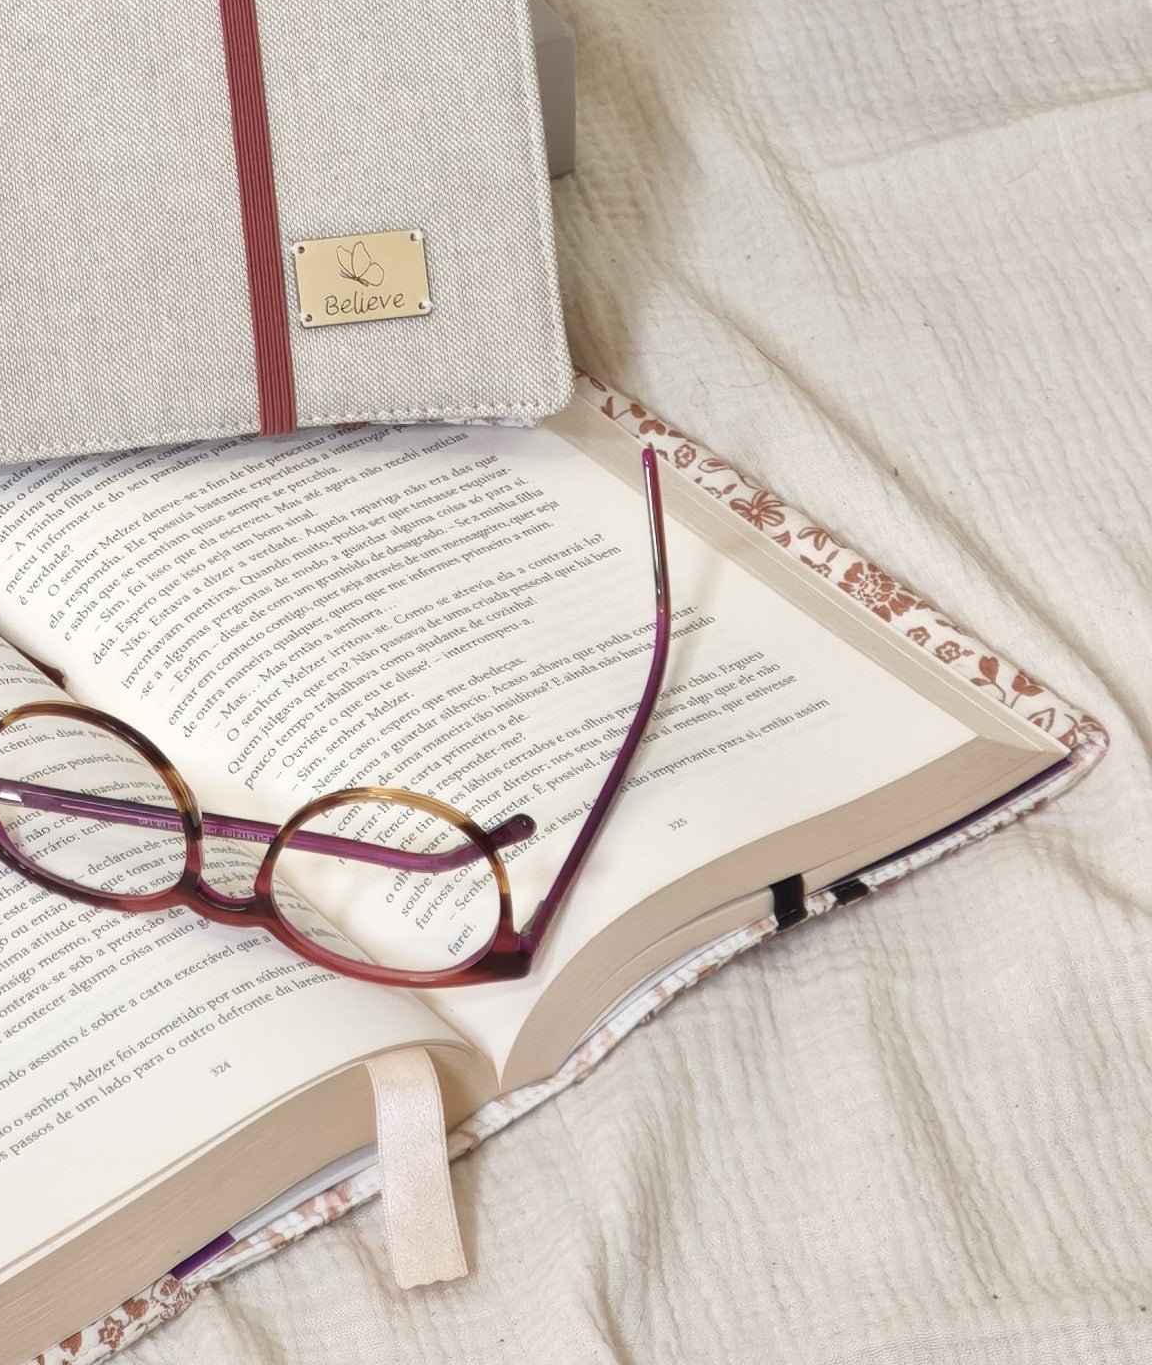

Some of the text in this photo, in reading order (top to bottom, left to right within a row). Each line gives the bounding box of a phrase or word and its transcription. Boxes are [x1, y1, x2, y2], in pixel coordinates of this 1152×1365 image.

[325, 290, 406, 316] Believe
[48, 456, 320, 630] ela respondia. Ele possuía bastante experiência
[91, 636, 119, 665] dela.
[113, 594, 158, 634] Espero
[156, 577, 182, 598] que
[178, 562, 207, 581] isso
[205, 548, 232, 566] seja
[250, 523, 285, 541] bom
[283, 507, 319, 528] sinal.
[667, 816, 688, 831] 325
[29, 918, 77, 950] atitude
[36, 934, 91, 969] mesmo,
[89, 916, 121, 940] pois
[7, 1121, 55, 1156] passos
[96, 1073, 132, 1097] lado
[131, 1052, 165, 1080] para
[177, 1021, 216, 1048] outro
[216, 992, 274, 1025] defronte
[289, 972, 340, 990] lareira.
[209, 1059, 232, 1077] 324
